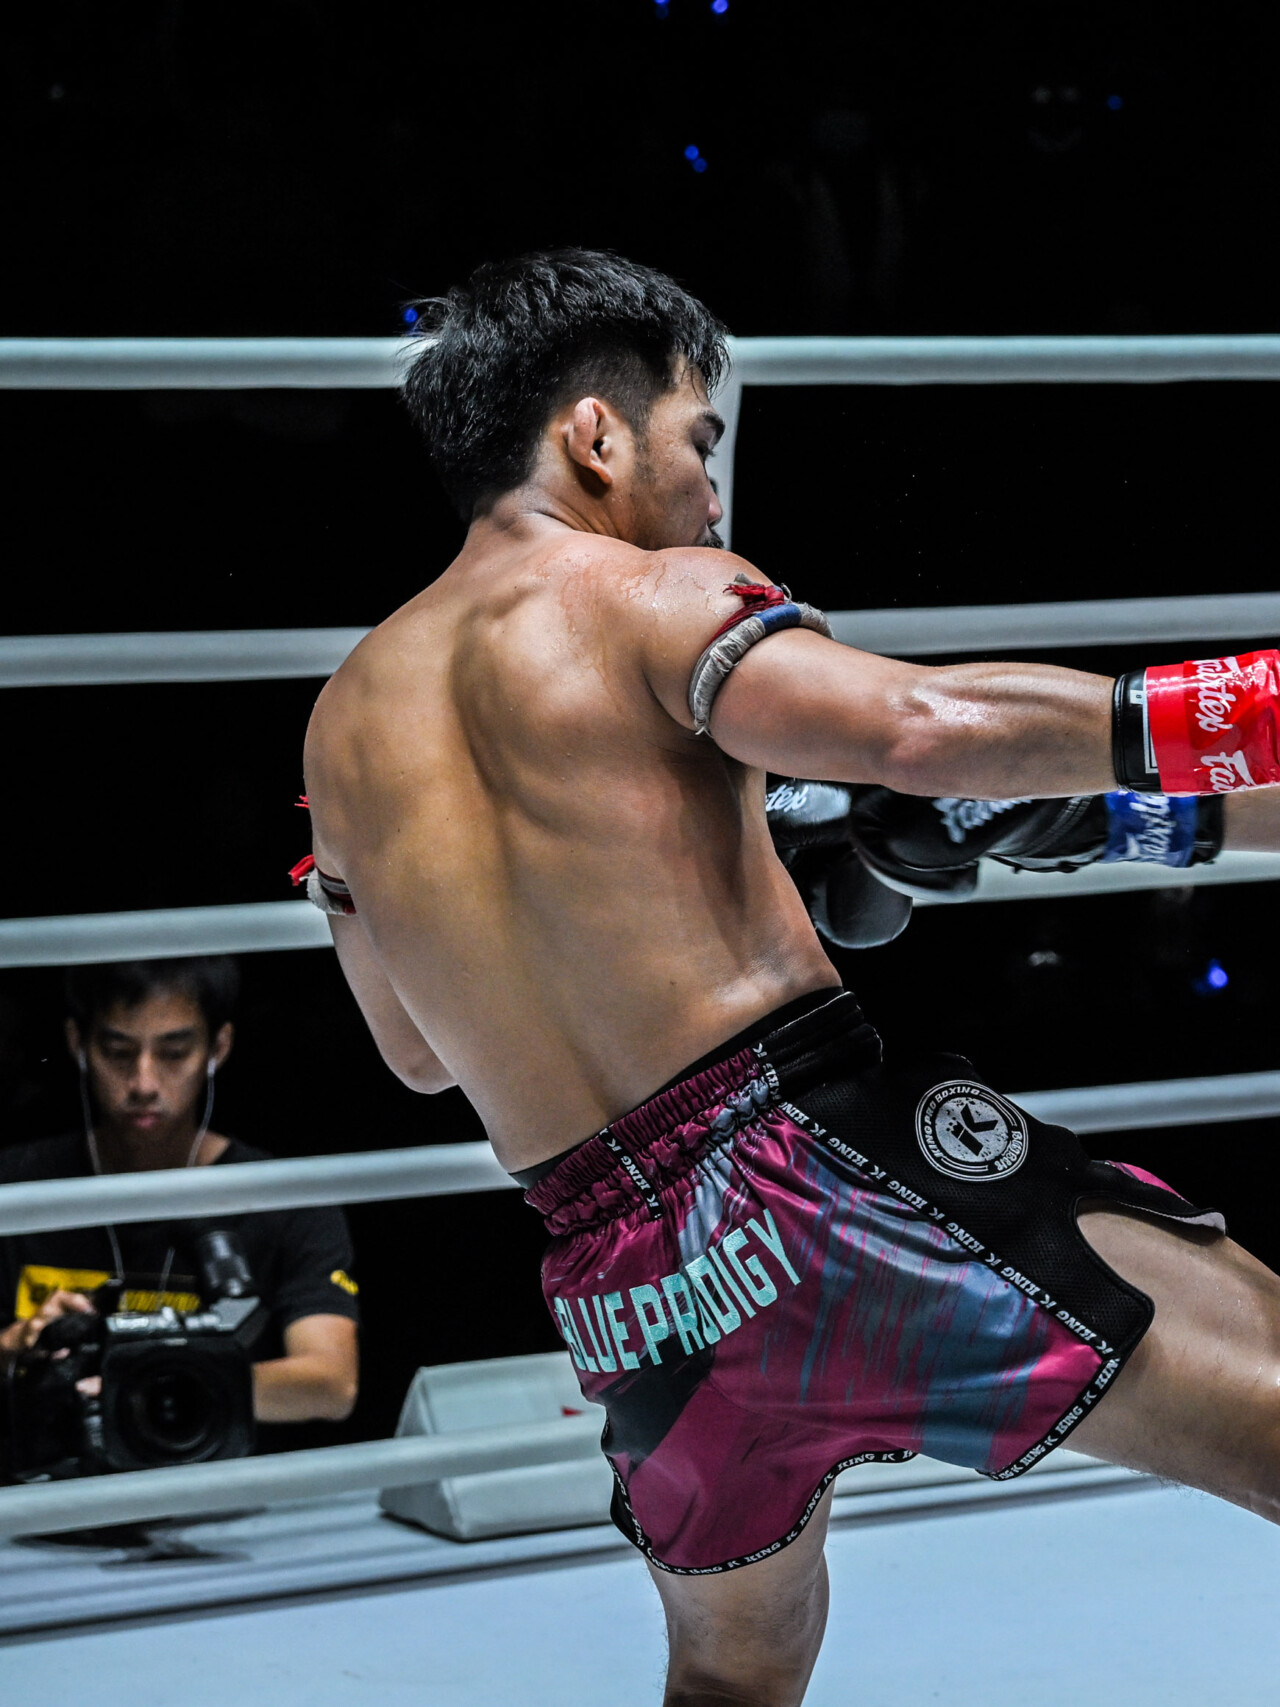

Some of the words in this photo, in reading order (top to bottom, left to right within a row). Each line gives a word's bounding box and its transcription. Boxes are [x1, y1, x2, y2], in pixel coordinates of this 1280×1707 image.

[935, 1086, 980, 1103] BOXING
[924, 1101, 936, 1125] PRO
[827, 1137, 869, 1166] KING
[924, 1126, 944, 1157] KING
[621, 1156, 651, 1190] KING
[887, 1180, 928, 1209] KING
[946, 1222, 985, 1253] KING
[554, 1291, 641, 1373] BLUE
[629, 1208, 801, 1365] PRODIGY
[1001, 1267, 1040, 1296] KING
[1056, 1310, 1097, 1340] KING
[1055, 1405, 1083, 1435] KING
[744, 1542, 781, 1563] KING
[800, 1488, 821, 1526] KING
[837, 1453, 875, 1471] KING
